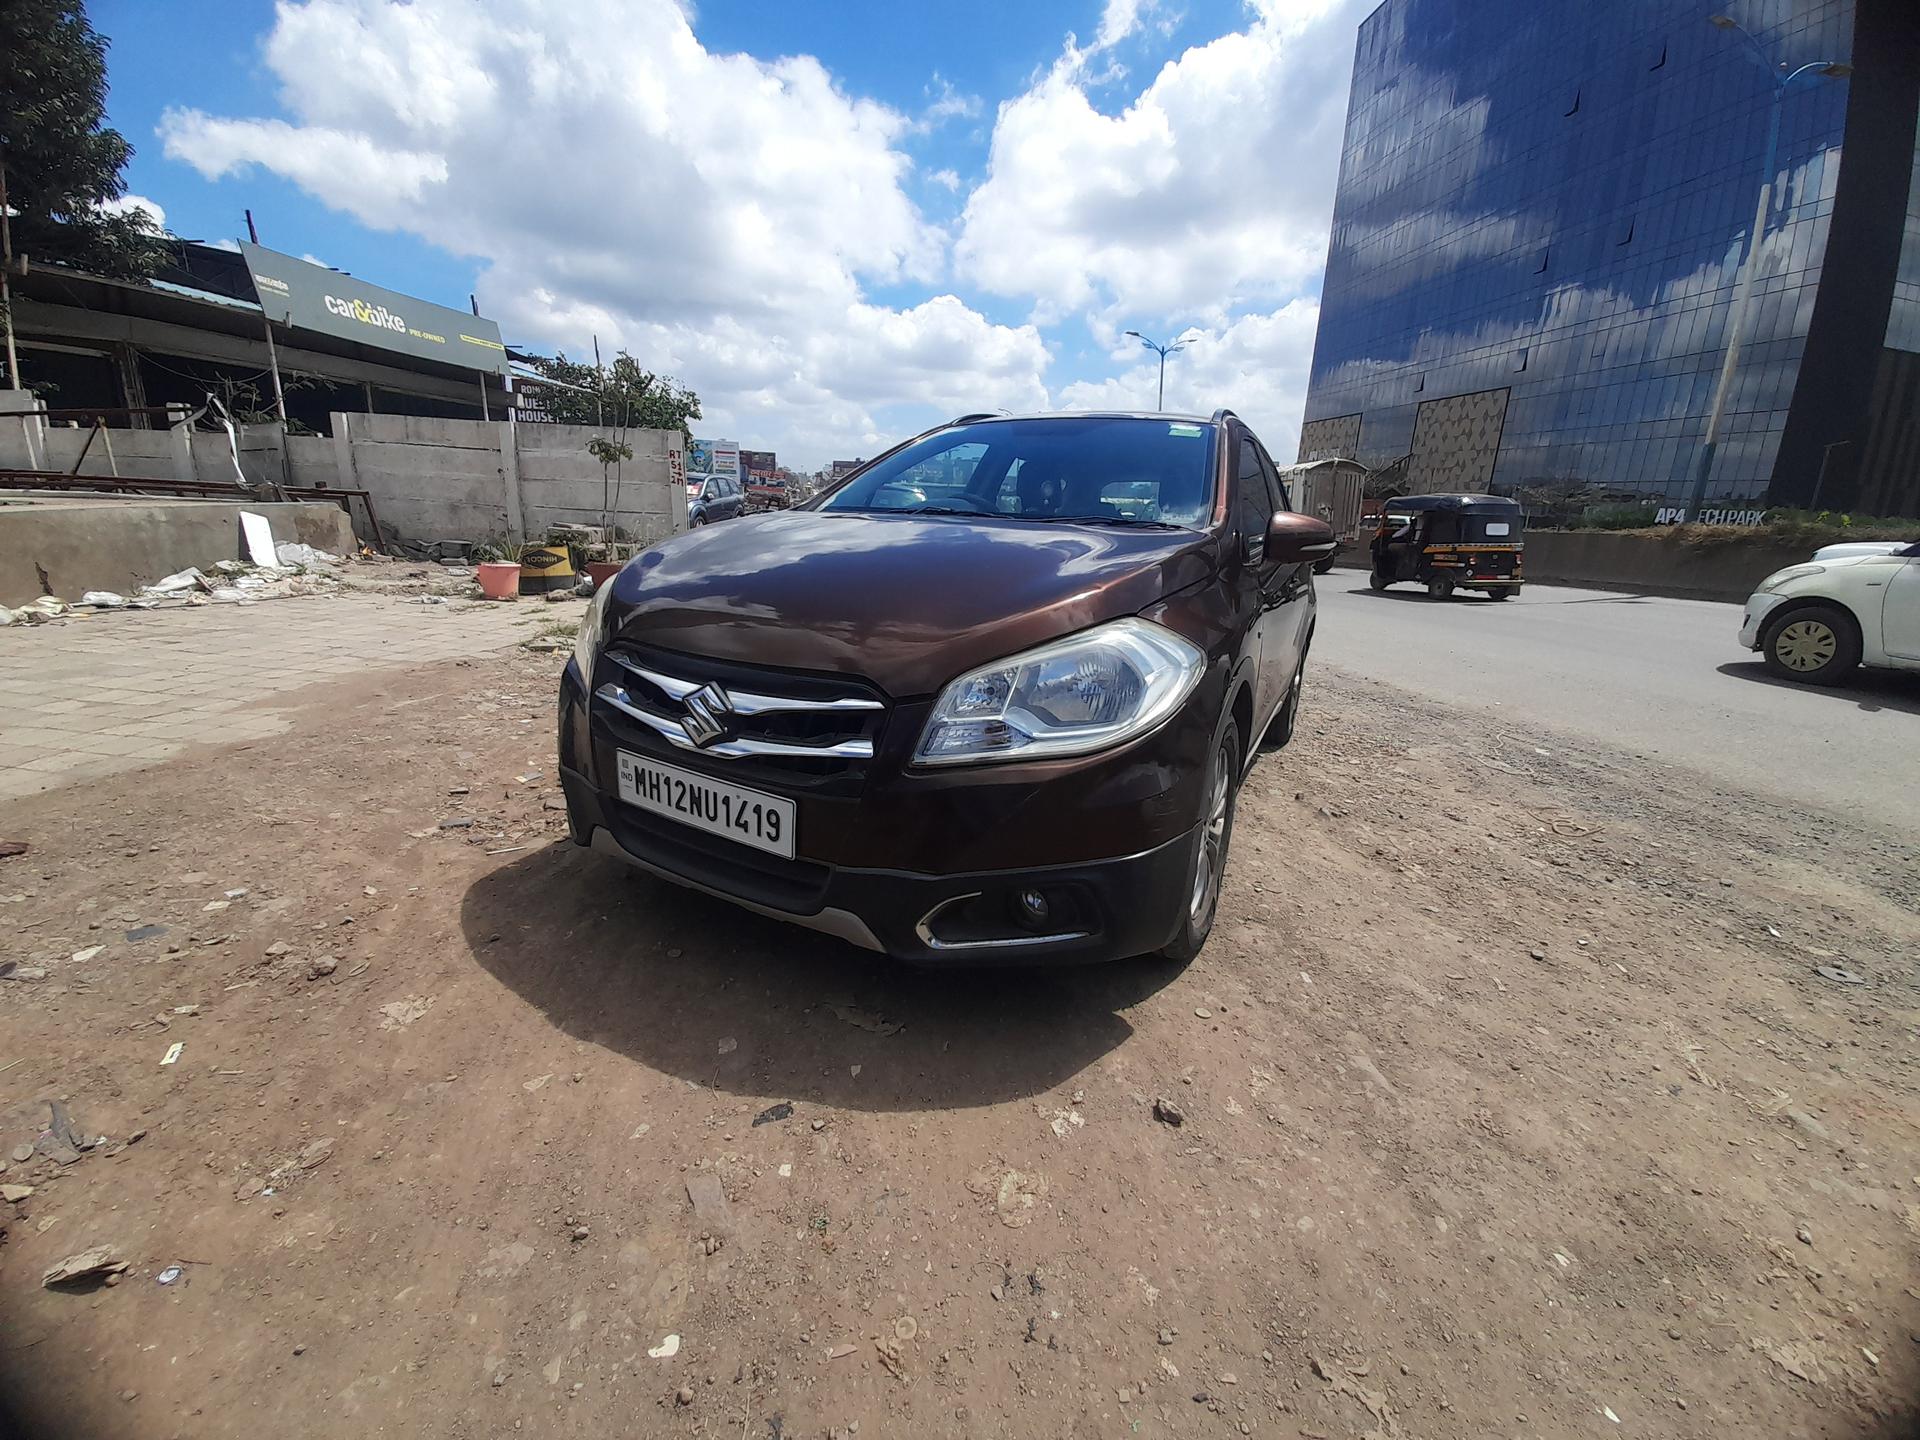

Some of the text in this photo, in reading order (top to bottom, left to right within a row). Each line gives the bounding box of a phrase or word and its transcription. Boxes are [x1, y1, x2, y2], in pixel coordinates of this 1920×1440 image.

[1654, 508, 1767, 527] AP4 ECH PARK
[634, 764, 781, 842] MH12NU1419
